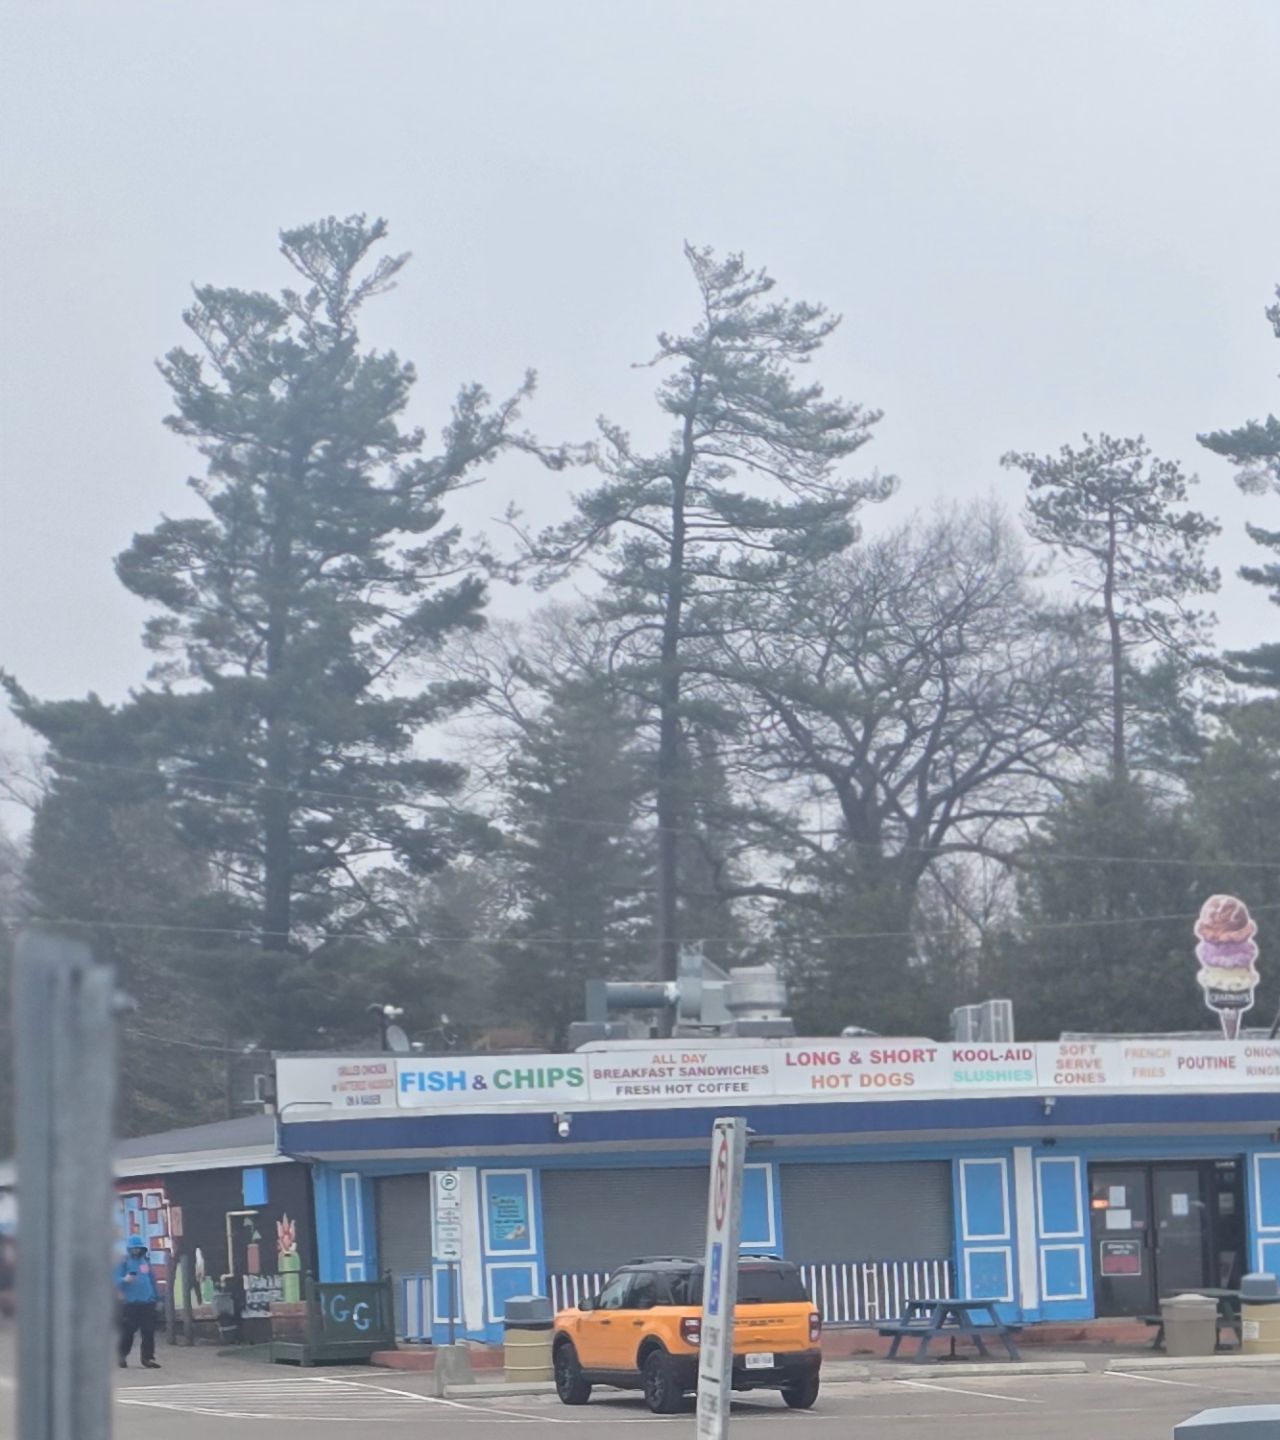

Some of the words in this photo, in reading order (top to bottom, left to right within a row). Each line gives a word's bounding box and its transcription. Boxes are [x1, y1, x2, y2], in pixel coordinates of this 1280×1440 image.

[953, 1048, 1033, 1063] KOOL-AID
[1059, 1044, 1097, 1056] SOFT
[1125, 1048, 1171, 1059] FRENCH
[1244, 1047, 1280, 1057] ONION
[652, 1054, 677, 1064] ALL
[681, 1053, 708, 1064] DAY
[786, 1052, 841, 1066] LONG
[849, 1051, 862, 1064] &
[870, 1048, 938, 1064] SHORT
[1177, 1056, 1236, 1070] POUTINE
[1056, 1058, 1103, 1070] SERVE
[593, 1067, 675, 1079] BREAKFAST
[679, 1065, 769, 1077] SANDWICHES
[953, 1069, 1033, 1082] SLUSHIES
[1132, 1067, 1165, 1078] FRIES
[1247, 1066, 1280, 1076] RINGS
[400, 1070, 467, 1092] FISH
[472, 1075, 487, 1090] &
[493, 1067, 584, 1090] CHIPS
[811, 1074, 852, 1089] HOT
[860, 1072, 915, 1088] DOGS
[1054, 1072, 1106, 1085] CONES
[616, 1085, 661, 1096] FRESH
[666, 1084, 693, 1094] HOT
[698, 1082, 749, 1093] COFFEE
